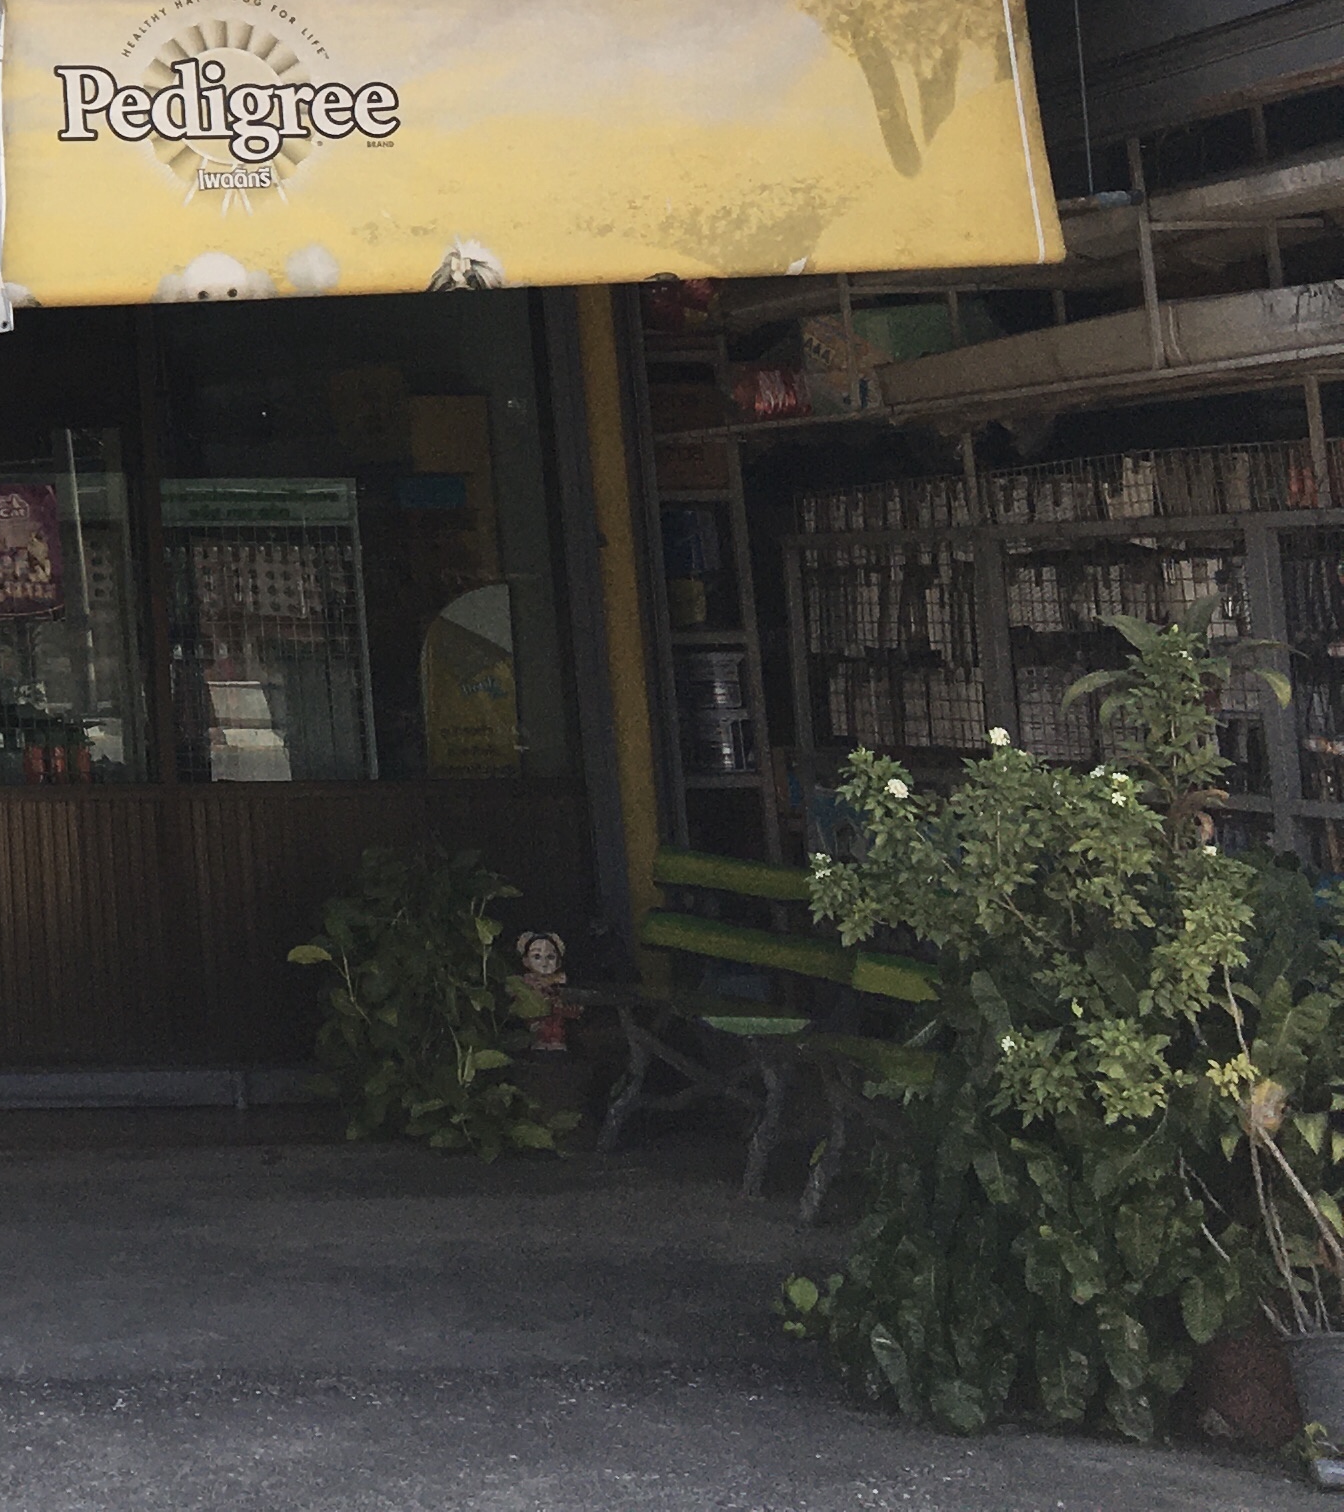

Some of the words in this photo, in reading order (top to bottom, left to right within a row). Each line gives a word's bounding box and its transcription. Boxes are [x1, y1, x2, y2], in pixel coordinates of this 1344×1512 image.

[121, 7, 168, 58] HEALTHY
[270, 4, 297, 25] FOR
[54, 58, 401, 164] Pedigree
